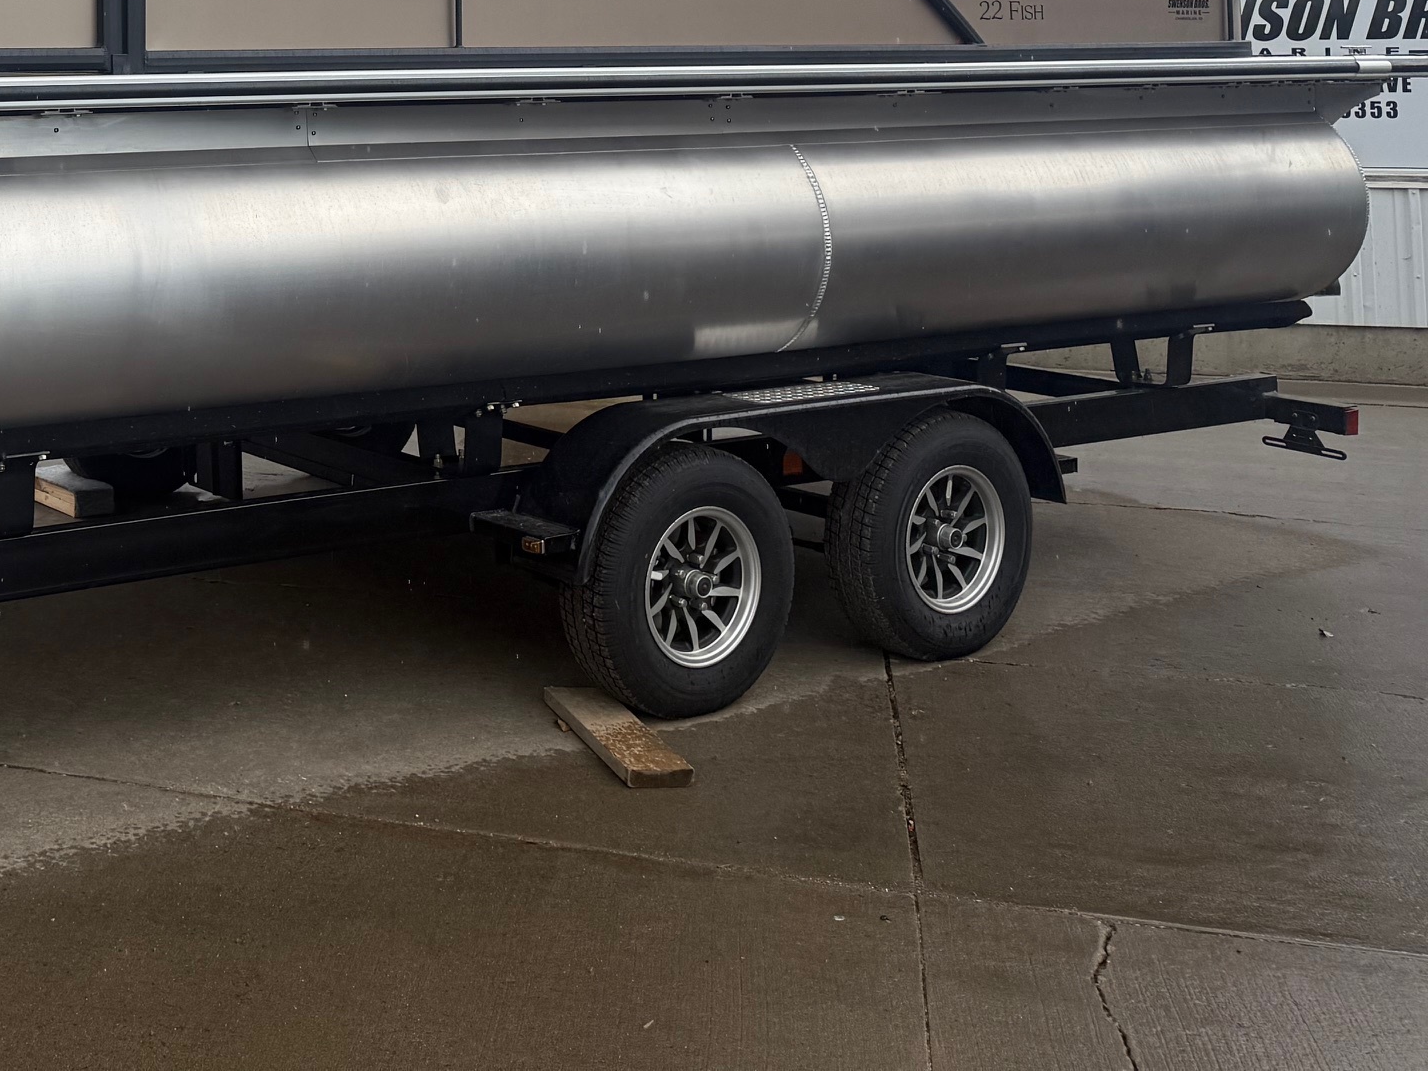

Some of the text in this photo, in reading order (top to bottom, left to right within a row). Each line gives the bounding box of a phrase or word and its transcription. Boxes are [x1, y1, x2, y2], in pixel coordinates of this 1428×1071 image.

[978, 0, 1045, 21] 22 FISH
[1258, 46, 1400, 57] ARINE
